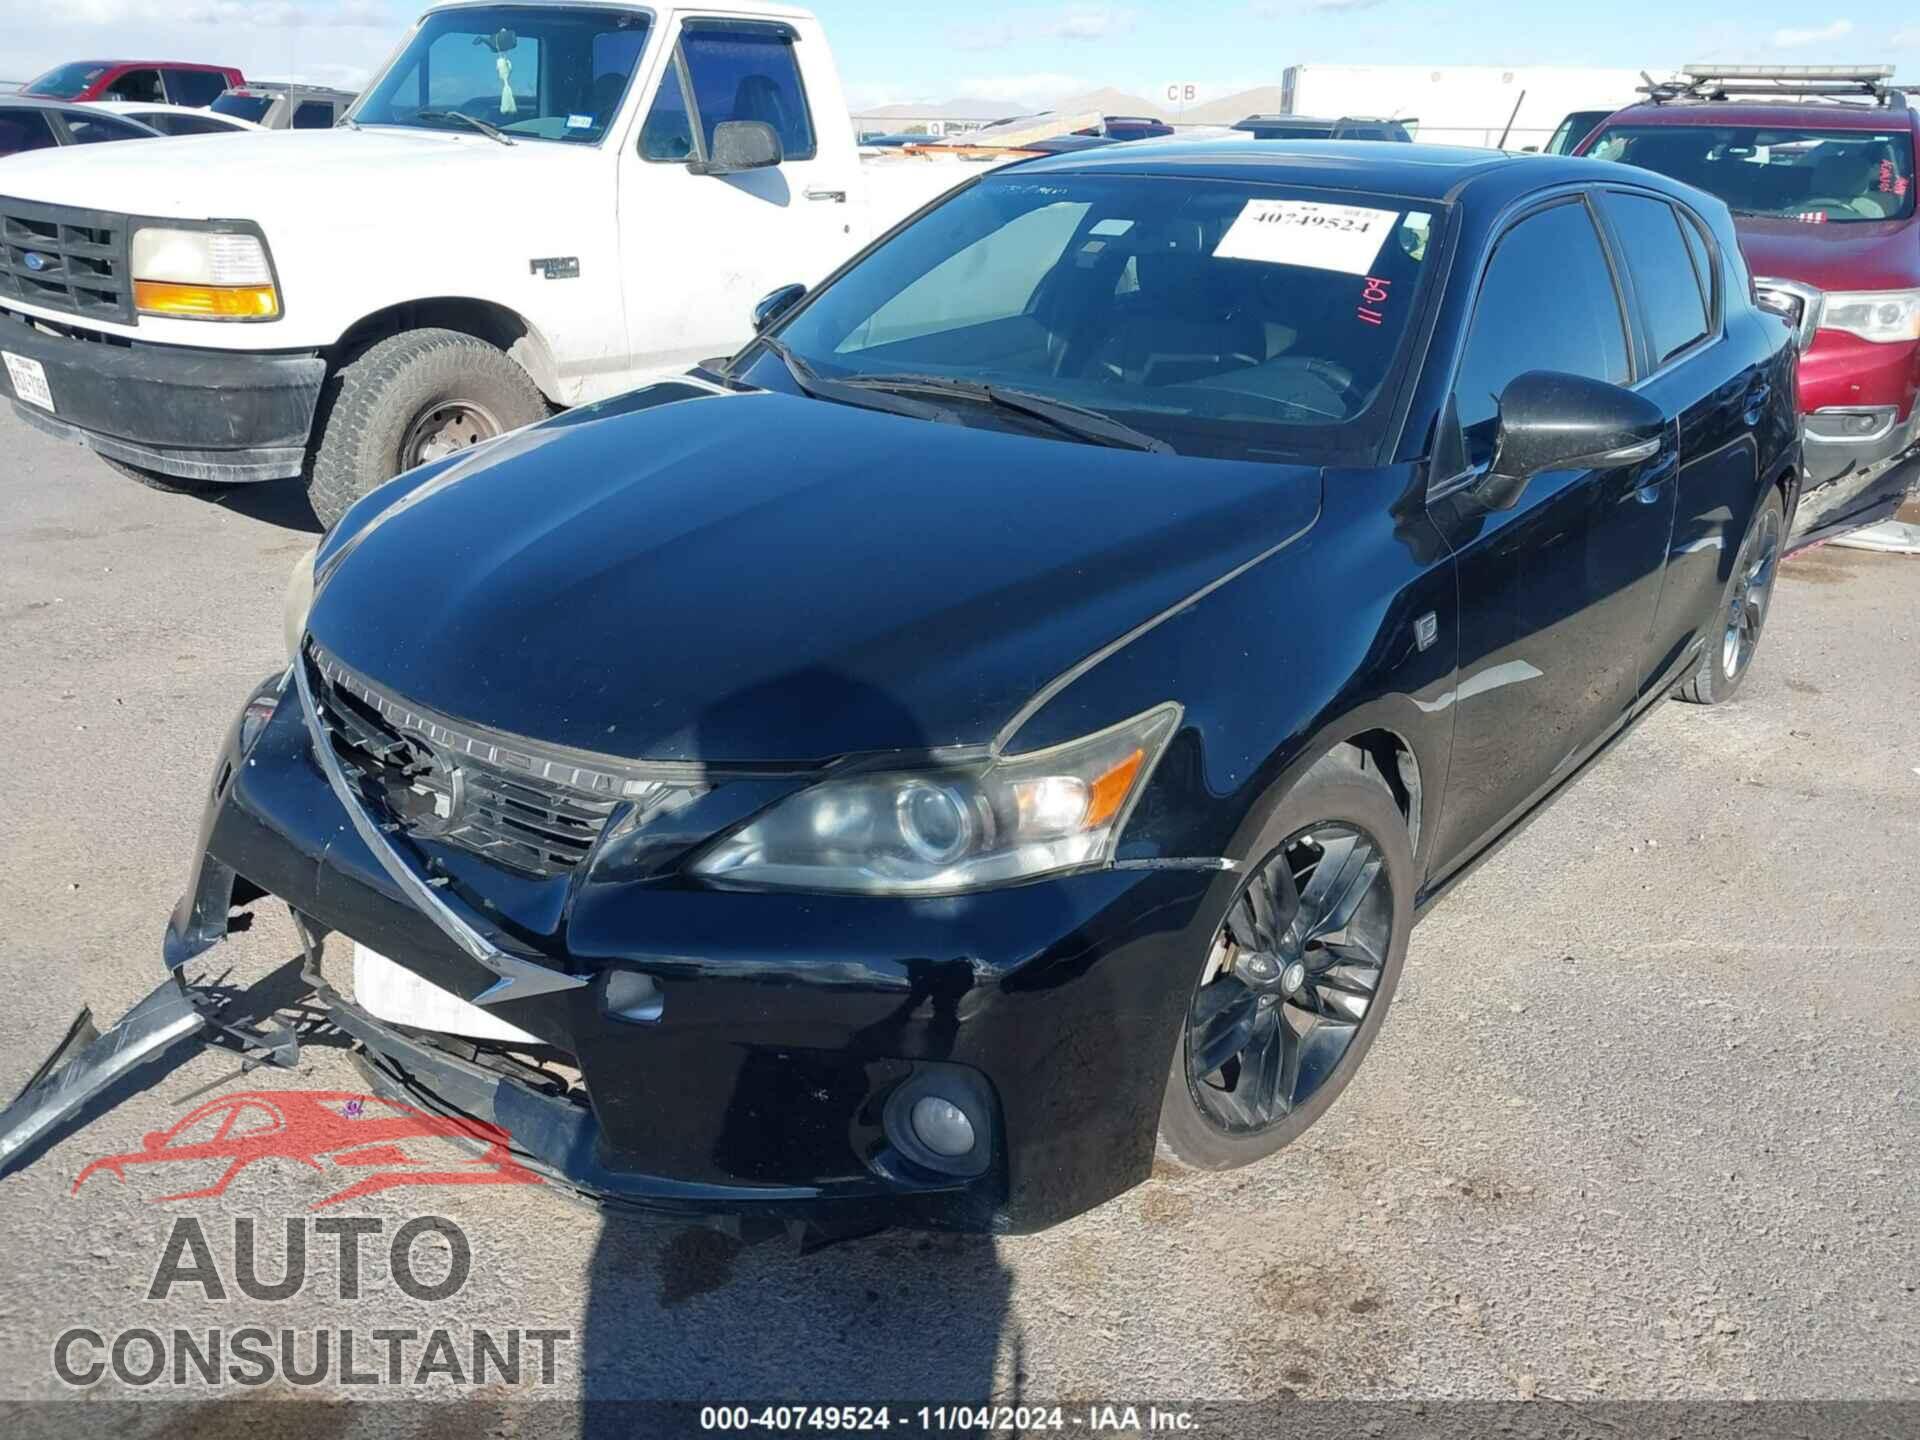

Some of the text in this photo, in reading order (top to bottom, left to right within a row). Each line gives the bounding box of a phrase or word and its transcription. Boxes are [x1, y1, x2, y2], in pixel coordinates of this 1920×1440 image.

[1168, 85, 1196, 101] C B
[1252, 211, 1371, 234] 40749524
